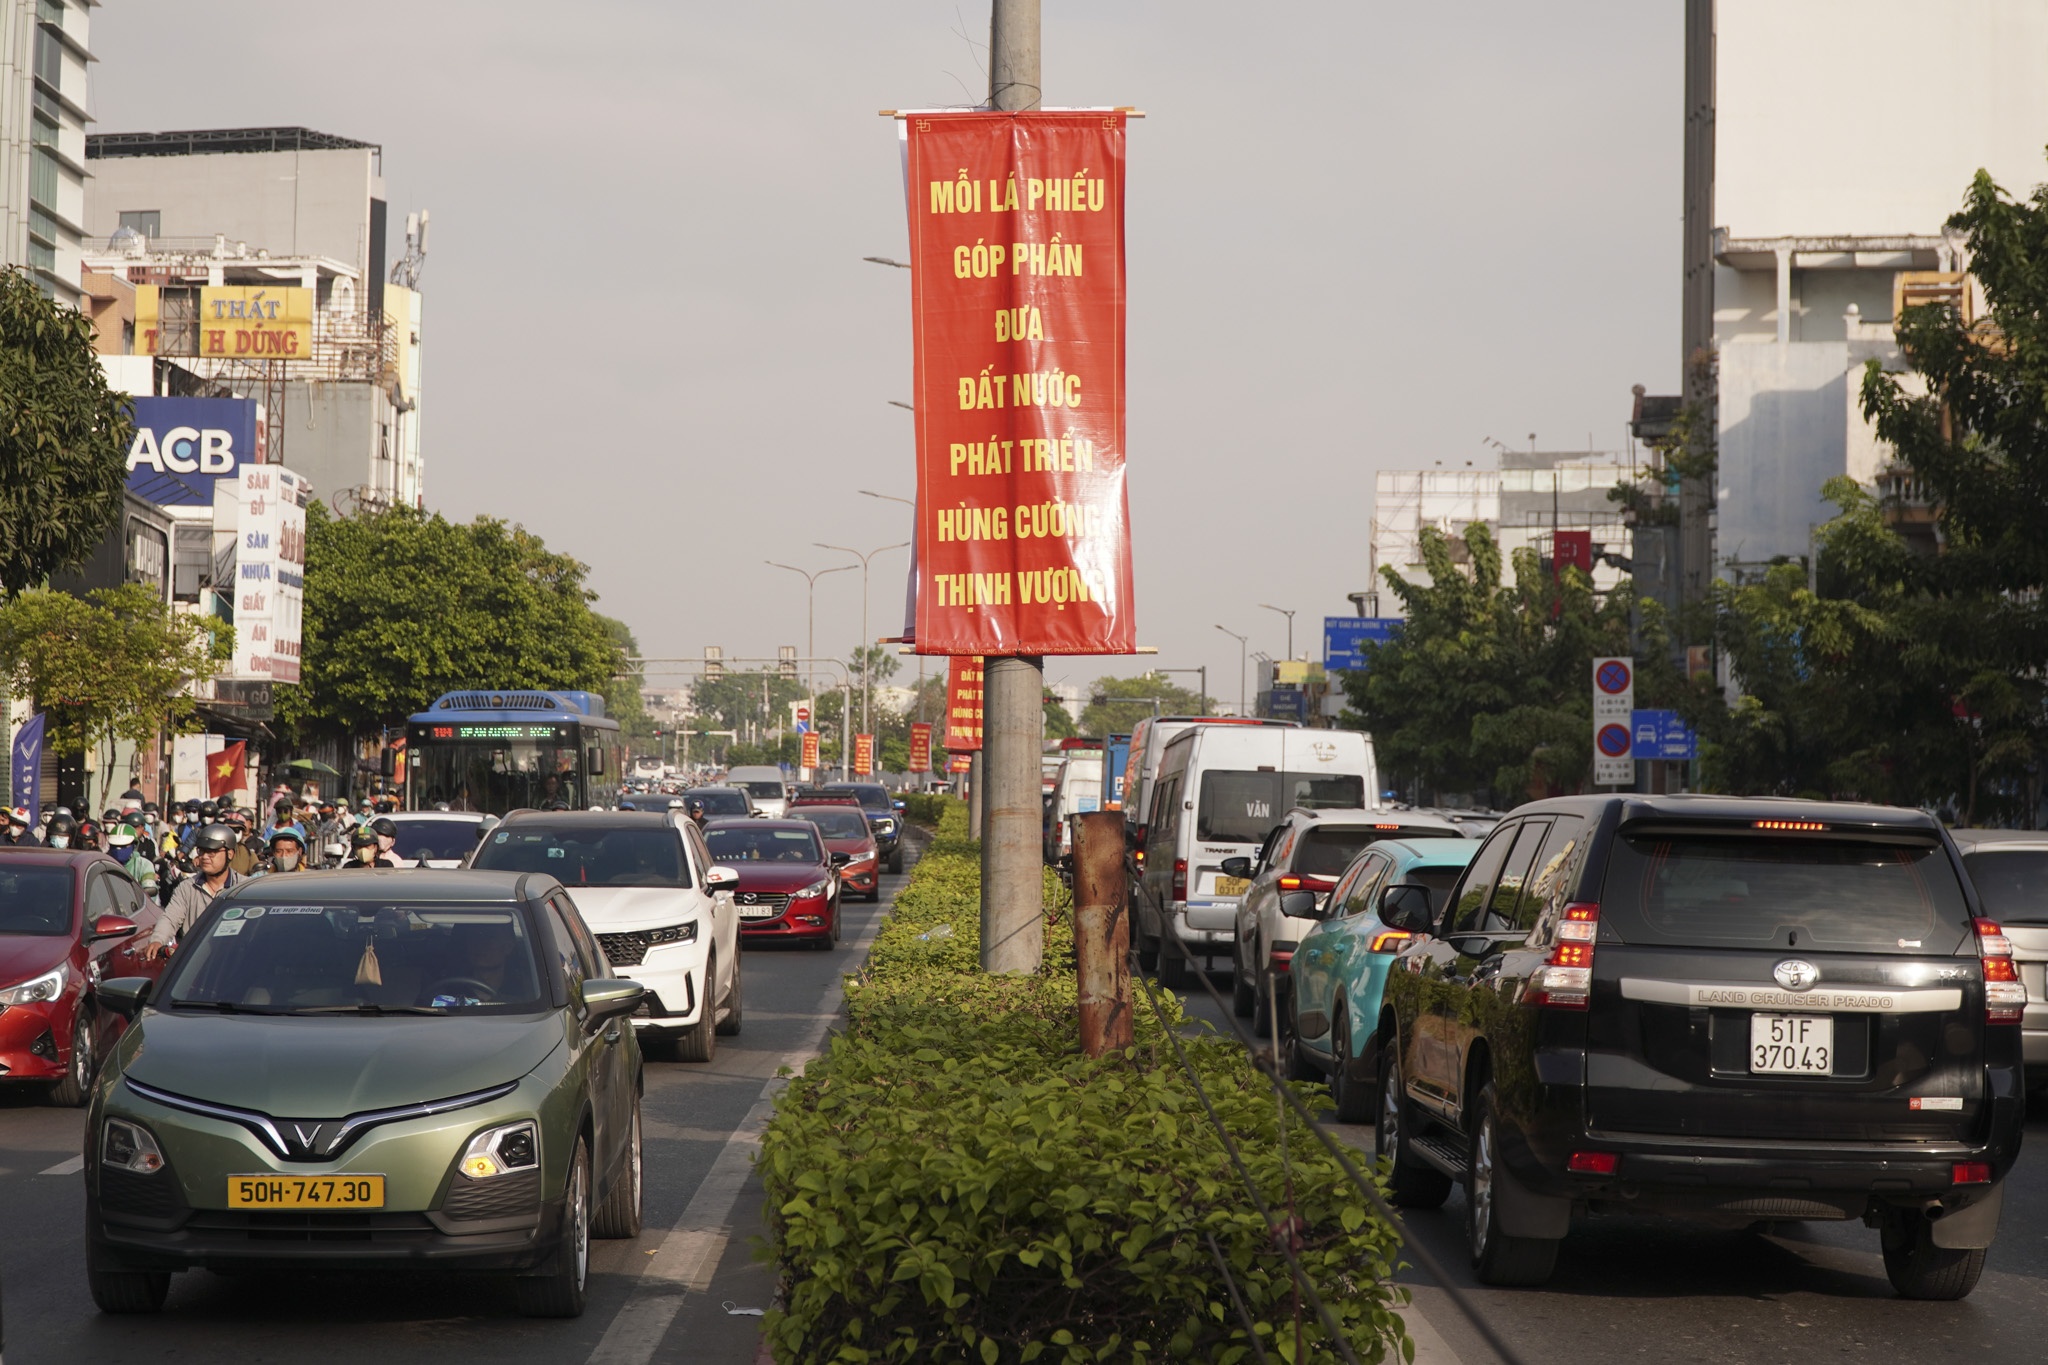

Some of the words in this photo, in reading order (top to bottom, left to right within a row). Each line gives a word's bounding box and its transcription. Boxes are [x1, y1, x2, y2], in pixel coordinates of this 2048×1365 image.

[930, 168, 981, 214] MỖI
[990, 172, 1019, 213] LÁ
[1028, 168, 1105, 212] PHIẾU
[954, 238, 1005, 279] GÓP
[1012, 232, 1082, 277] PHẦN
[211, 290, 280, 319] THẤT
[995, 304, 1044, 343] ĐƯA
[958, 364, 1007, 411] ĐẤT
[1013, 367, 1081, 407] NƯỚC
[125, 426, 235, 474] ACB
[950, 435, 1013, 476] PHÁT
[1020, 426, 1093, 473] TRIỂN
[247, 472, 270, 490] SÀN
[938, 501, 1008, 542] HÙNG
[246, 530, 269, 549] SÀN
[241, 562, 271, 582] NHỰA
[935, 571, 1011, 613] THỊNH
[1246, 800, 1270, 818] VĂN
[1698, 990, 1747, 1004] LAND
[1751, 992, 1830, 1006] CRUISER
[1833, 995, 1893, 1009] PRADO
[1771, 1019, 1813, 1044] 51F
[1755, 1045, 1828, 1071] 370.43
[240, 1181, 371, 1203] 50H-747.30
